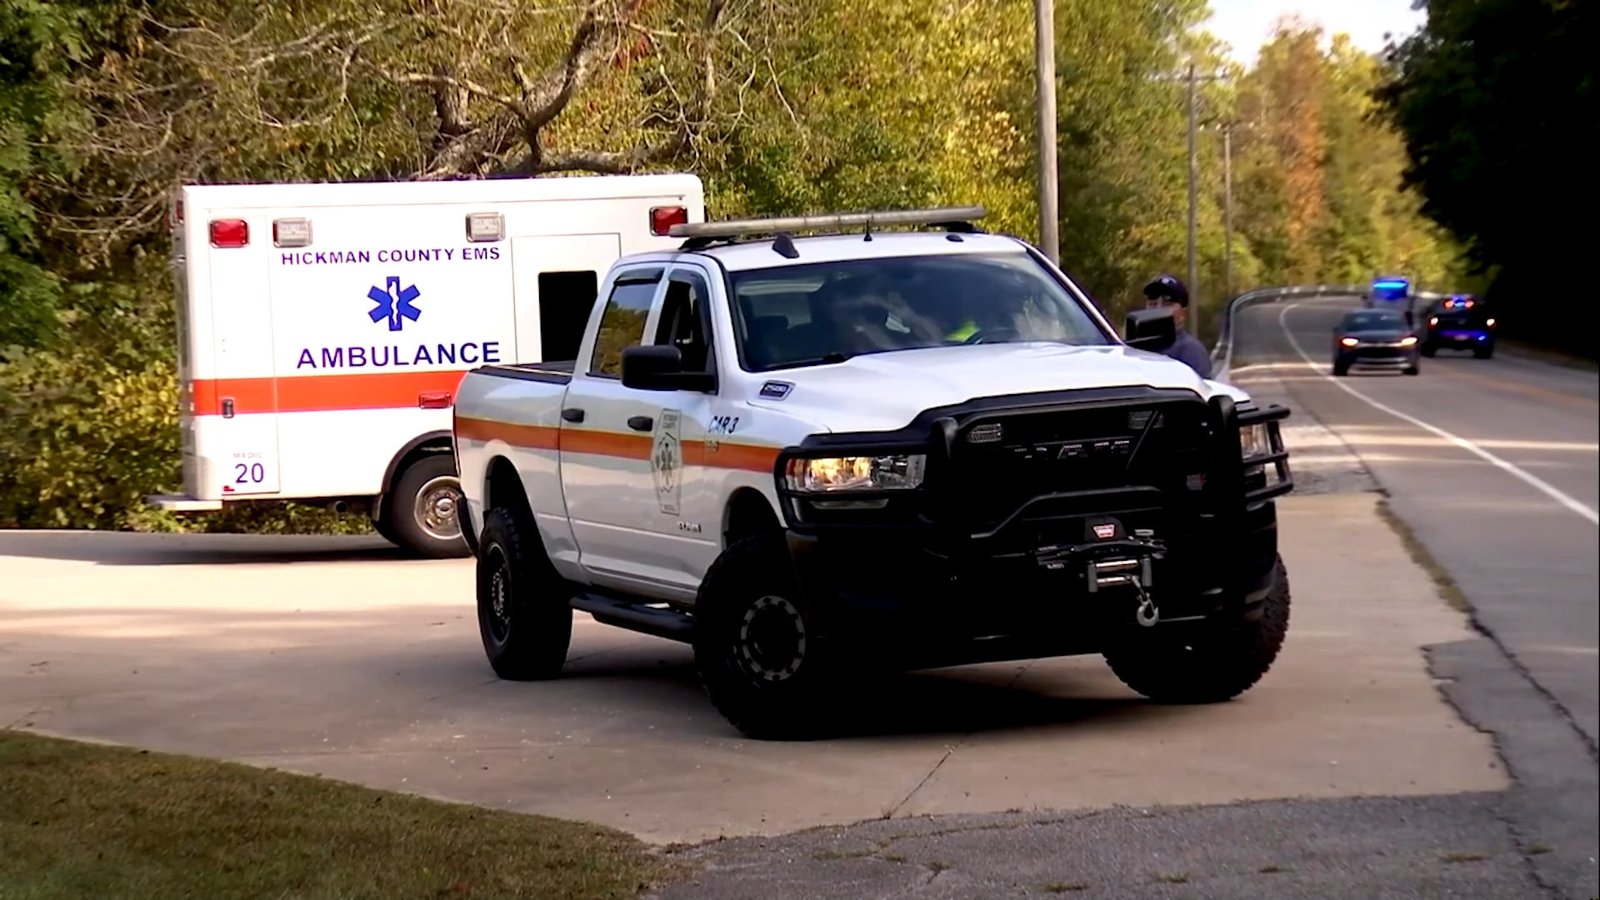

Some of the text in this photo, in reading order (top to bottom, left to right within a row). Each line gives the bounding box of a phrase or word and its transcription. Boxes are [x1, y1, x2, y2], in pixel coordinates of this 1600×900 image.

[281, 246, 501, 265] HICKMAN COUNTY EMS
[296, 341, 501, 369] AMBULANCE
[729, 416, 740, 434] 3
[235, 463, 264, 484] 20
